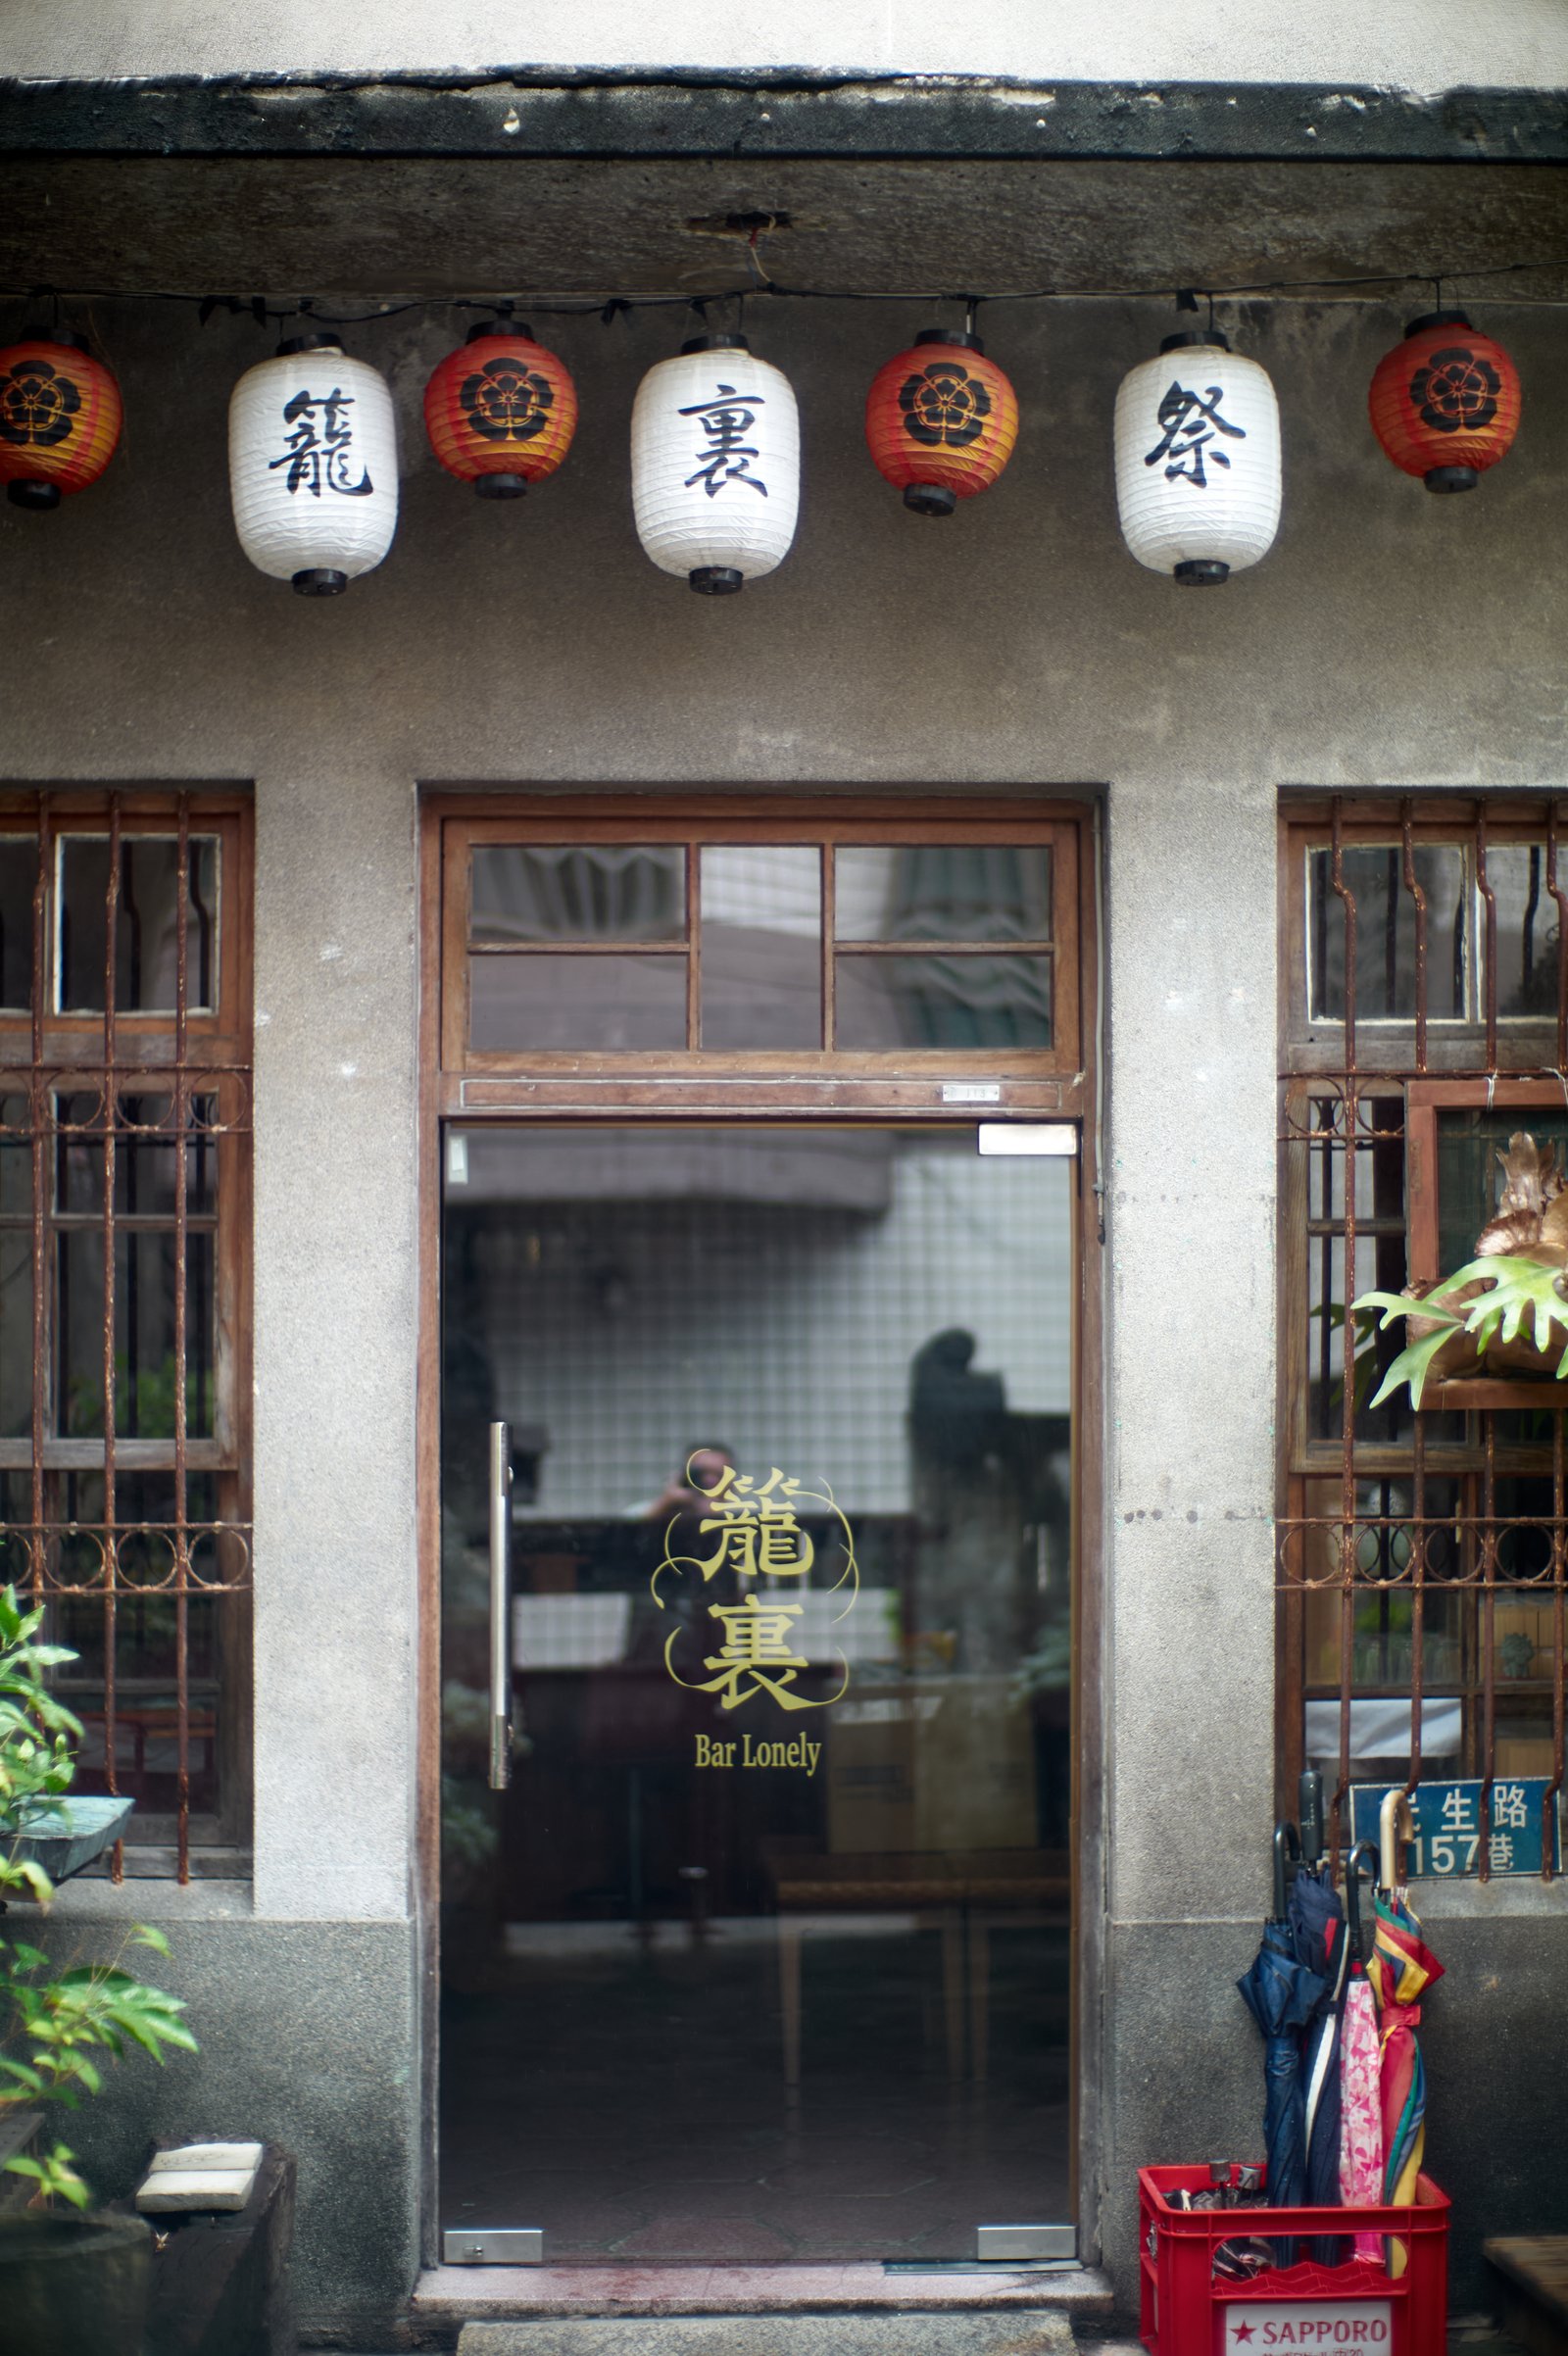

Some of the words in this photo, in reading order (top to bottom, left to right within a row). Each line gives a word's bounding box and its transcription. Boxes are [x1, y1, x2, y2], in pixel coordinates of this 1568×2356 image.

[270, 387, 374, 498] 籠
[678, 383, 768, 499] 裏
[1144, 380, 1247, 489] 祭
[695, 1734, 735, 1767] Bar
[742, 1731, 821, 1777] Lonely
[1412, 1833, 1514, 1875] 157巷
[1262, 2319, 1388, 2345] SAPPORO
